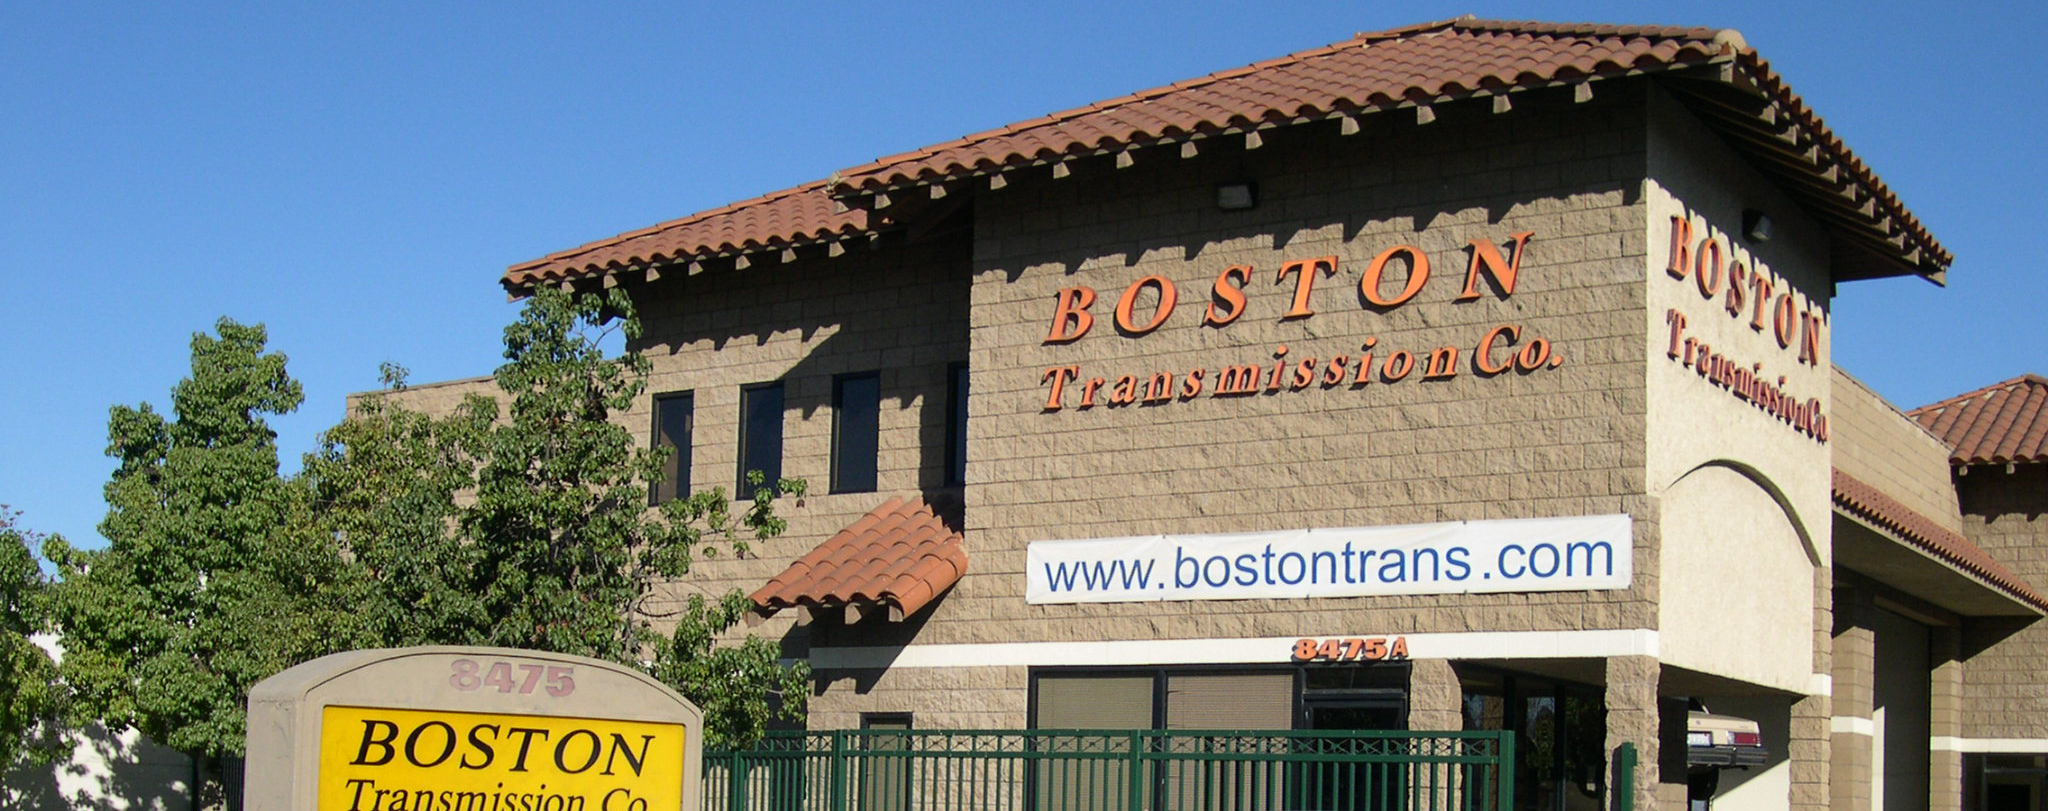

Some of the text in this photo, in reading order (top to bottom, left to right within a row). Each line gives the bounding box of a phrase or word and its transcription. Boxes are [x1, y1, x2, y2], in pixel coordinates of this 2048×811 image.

[1042, 231, 1534, 345] BOSTON
[1666, 216, 1821, 367] BOSTON
[1041, 324, 1562, 412] Transmission Co.
[1045, 540, 1614, 592] www.bostontrans.com
[449, 659, 576, 697] 8475
[349, 719, 655, 777] BOSTON
[345, 779, 586, 811] Transmission
